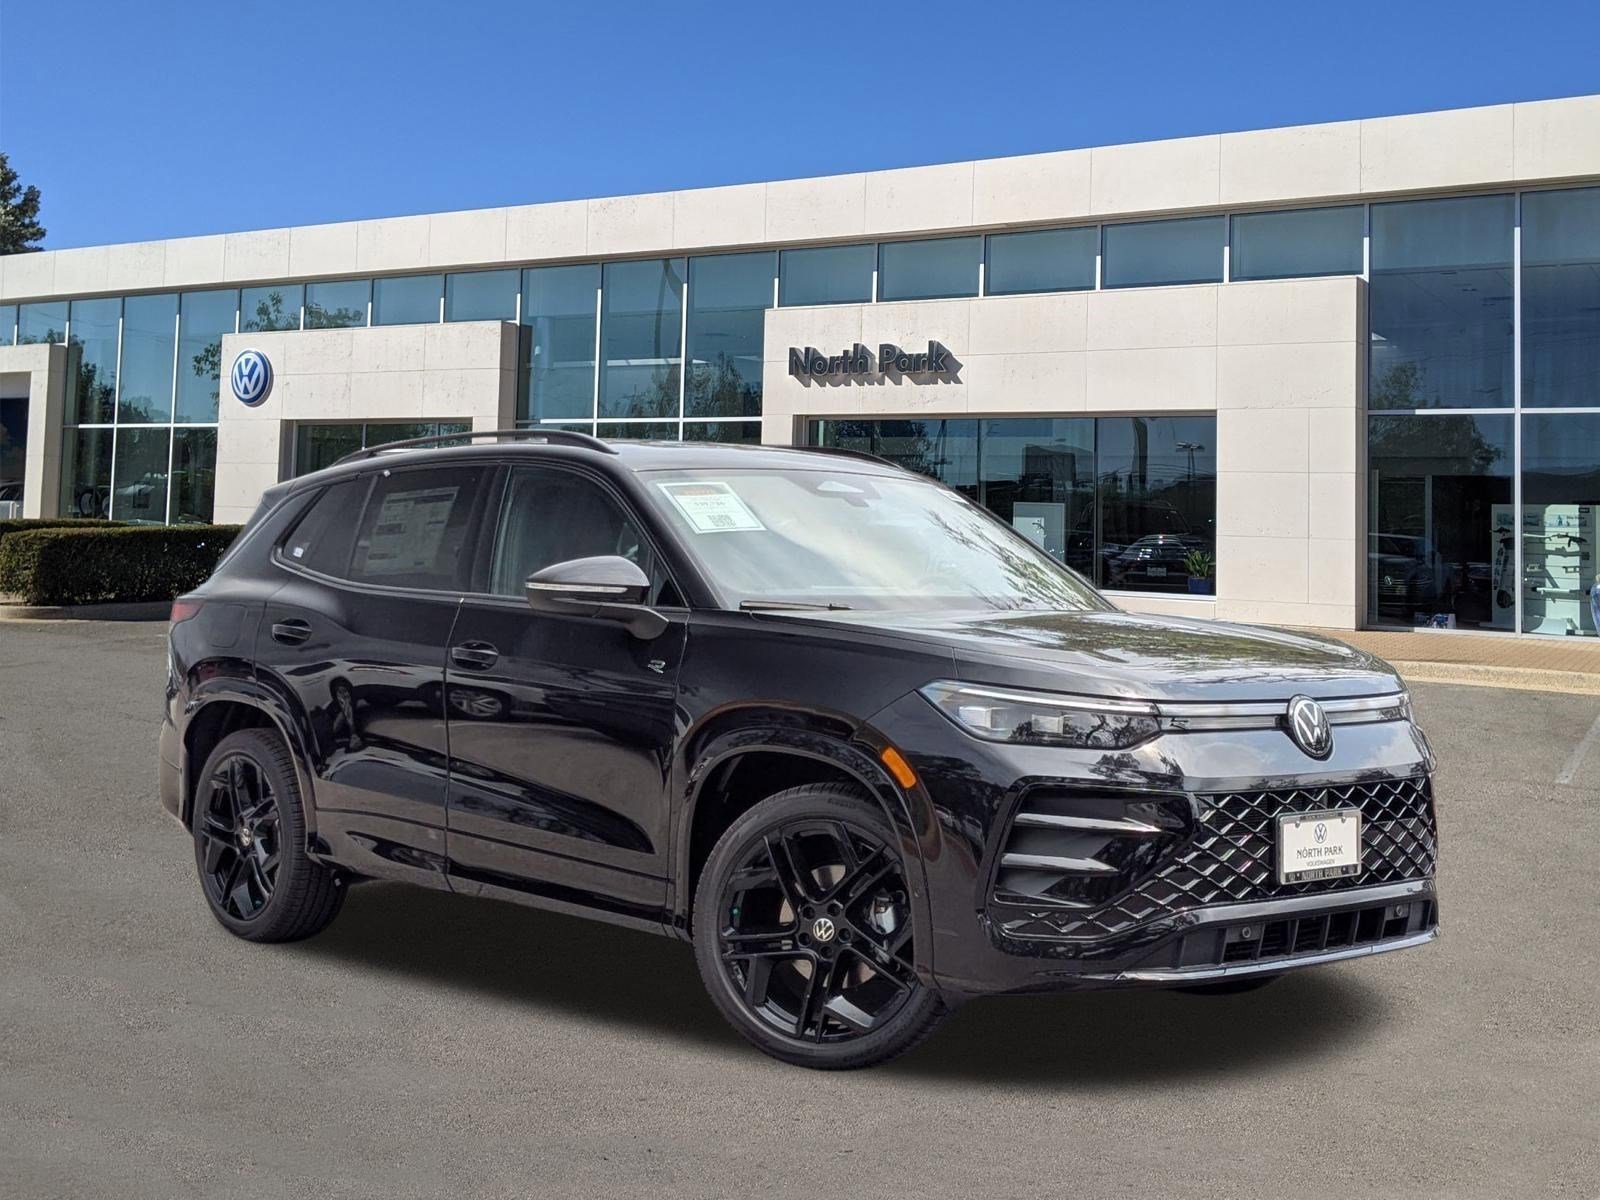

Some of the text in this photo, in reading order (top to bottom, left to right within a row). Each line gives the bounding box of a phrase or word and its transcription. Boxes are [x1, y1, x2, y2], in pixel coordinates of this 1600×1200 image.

[789, 340, 951, 376] North Park
[1324, 845, 1344, 857] PARK
[1302, 869, 1323, 881] NORTH
